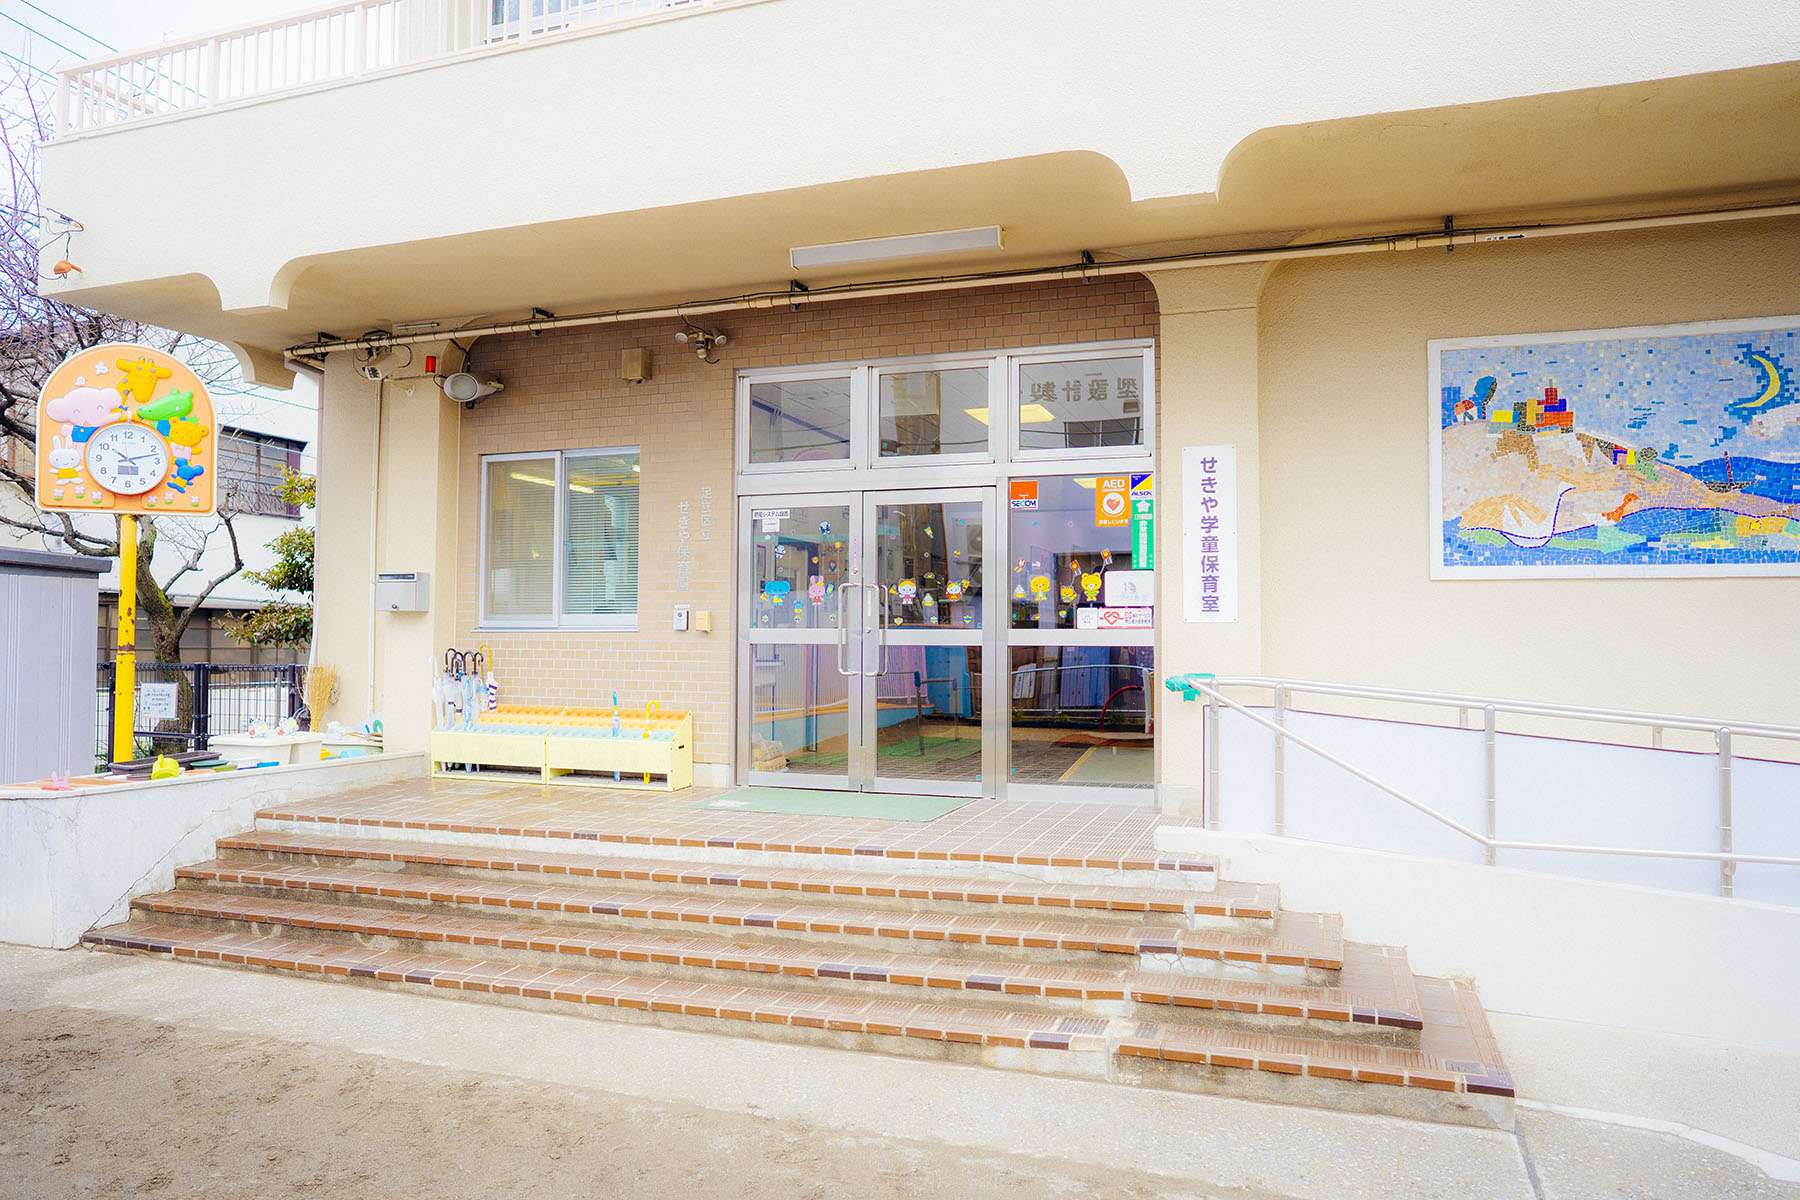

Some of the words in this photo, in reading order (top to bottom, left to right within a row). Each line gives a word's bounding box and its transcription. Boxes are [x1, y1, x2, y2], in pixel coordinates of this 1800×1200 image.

[110, 434, 118, 442] 11
[123, 431, 134, 439] 12
[98, 442, 110, 450] 10
[124, 480, 132, 488] 6
[1102, 479, 1126, 488] AED
[701, 488, 712, 541] 足立区立
[1200, 457, 1220, 612] せきや学童保育室
[678, 500, 690, 591] せきや保育園
